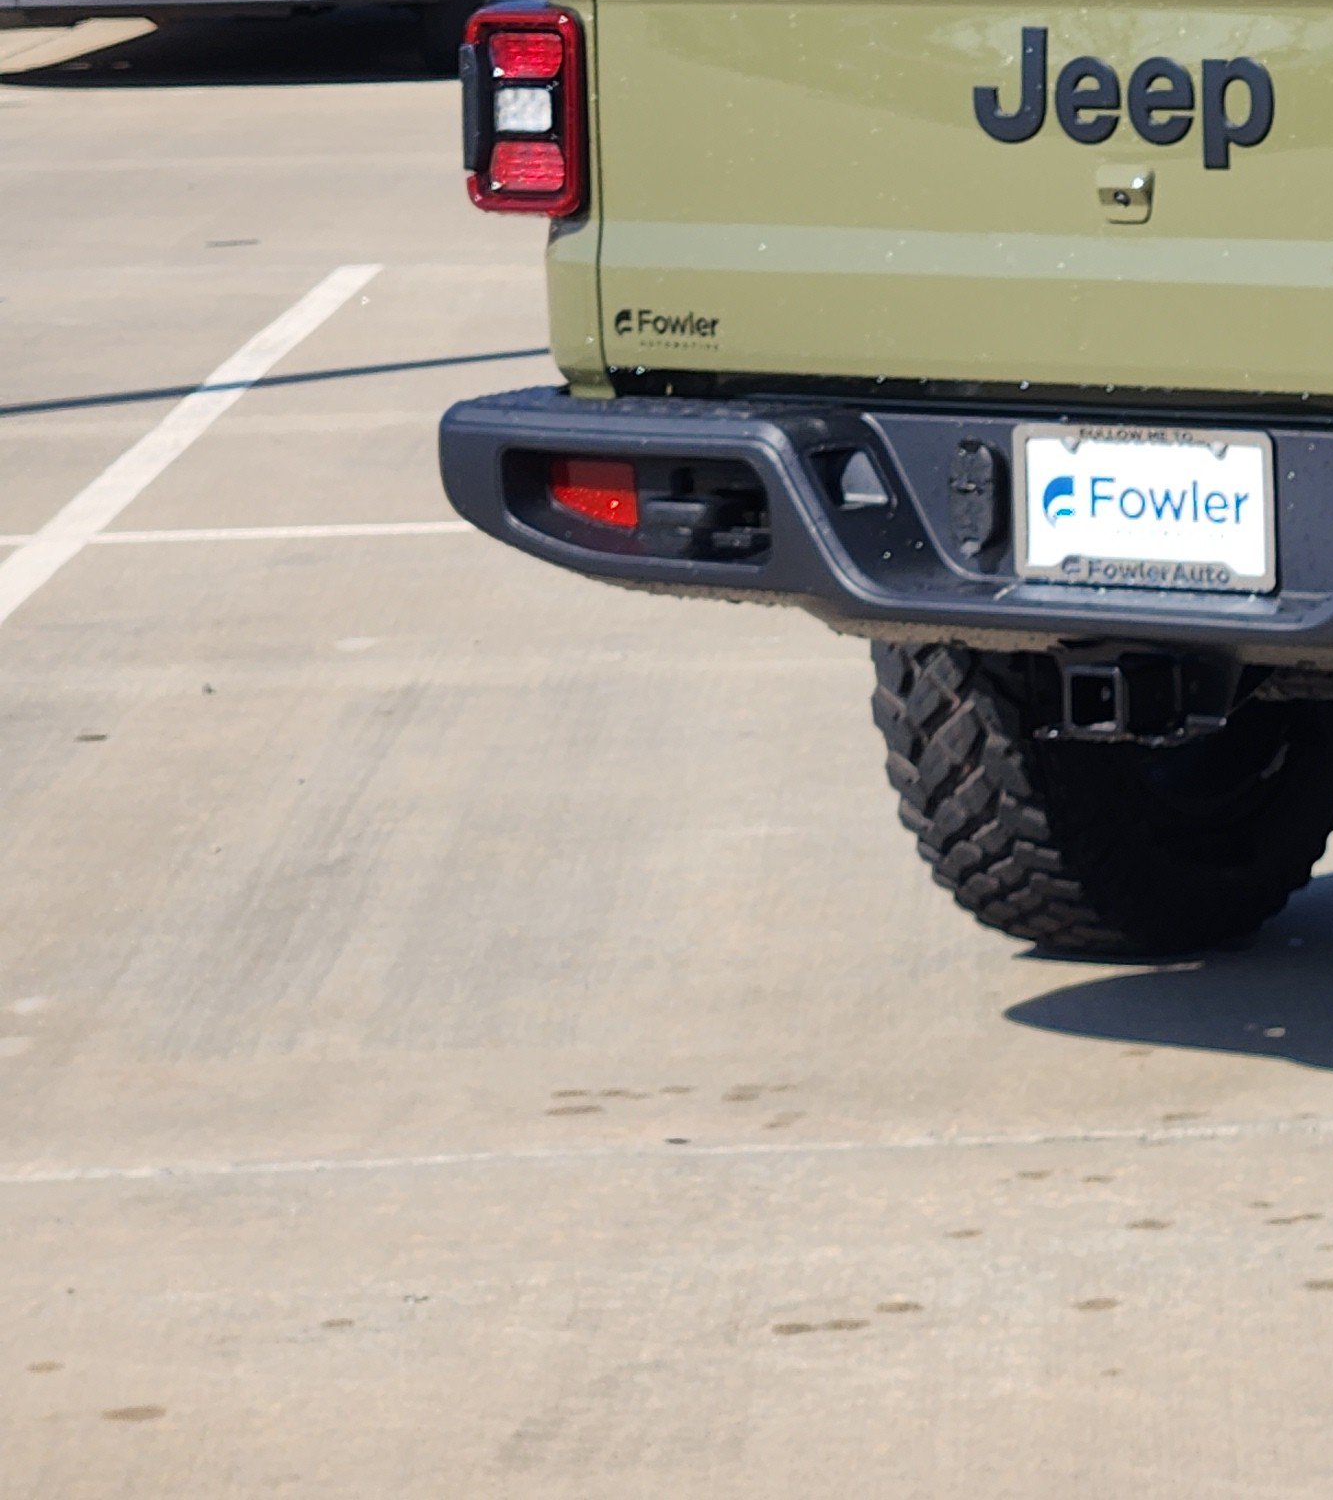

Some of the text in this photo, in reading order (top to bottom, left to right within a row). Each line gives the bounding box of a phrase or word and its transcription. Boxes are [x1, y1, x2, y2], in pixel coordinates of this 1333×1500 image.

[973, 26, 1275, 170] Jeep
[638, 309, 719, 337] Fowler
[1079, 428, 1142, 443] FOLLOW
[1090, 476, 1249, 524] Fowler
